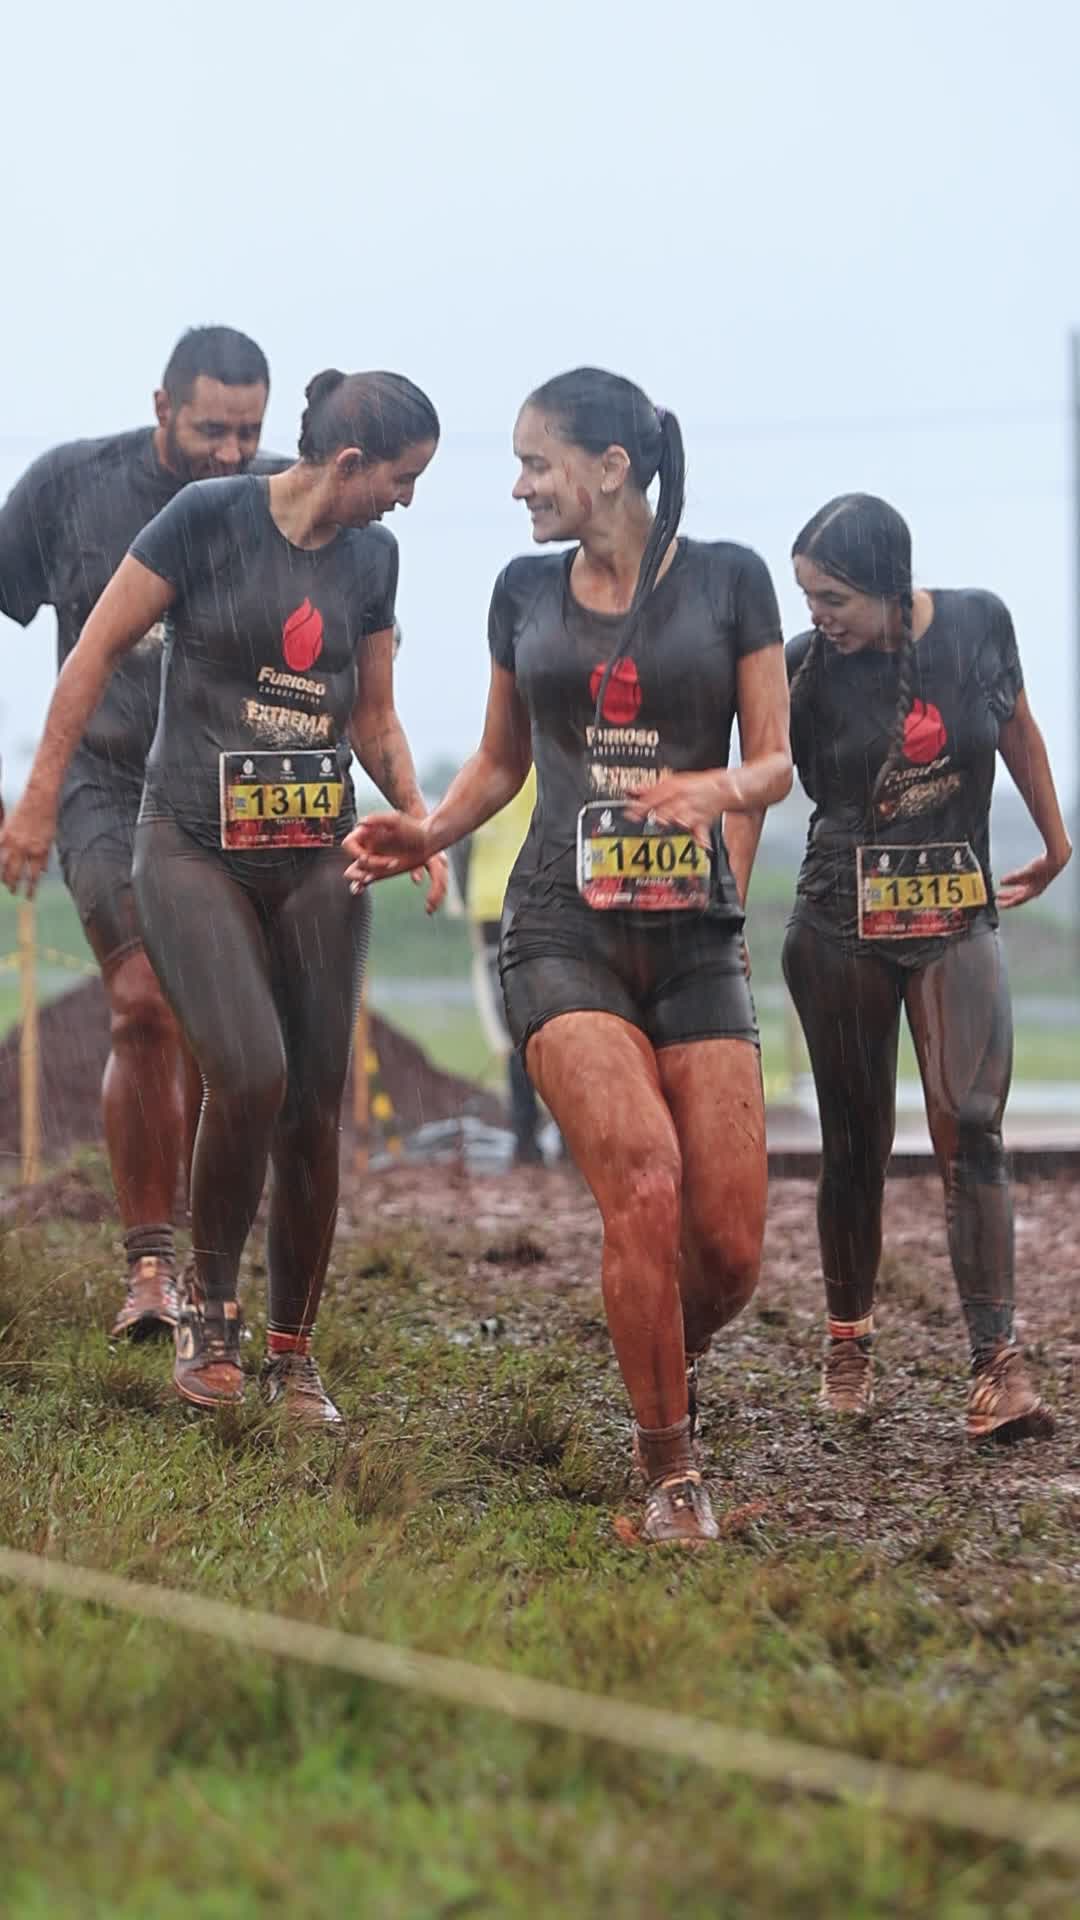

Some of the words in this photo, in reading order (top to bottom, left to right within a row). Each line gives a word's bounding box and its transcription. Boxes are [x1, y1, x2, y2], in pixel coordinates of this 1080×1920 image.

[258, 666, 326, 696] FURIOSO
[246, 700, 331, 736] EXTREMA
[251, 785, 331, 817] 1314
[608, 838, 700, 873] 1404
[886, 877, 964, 907] 1315
